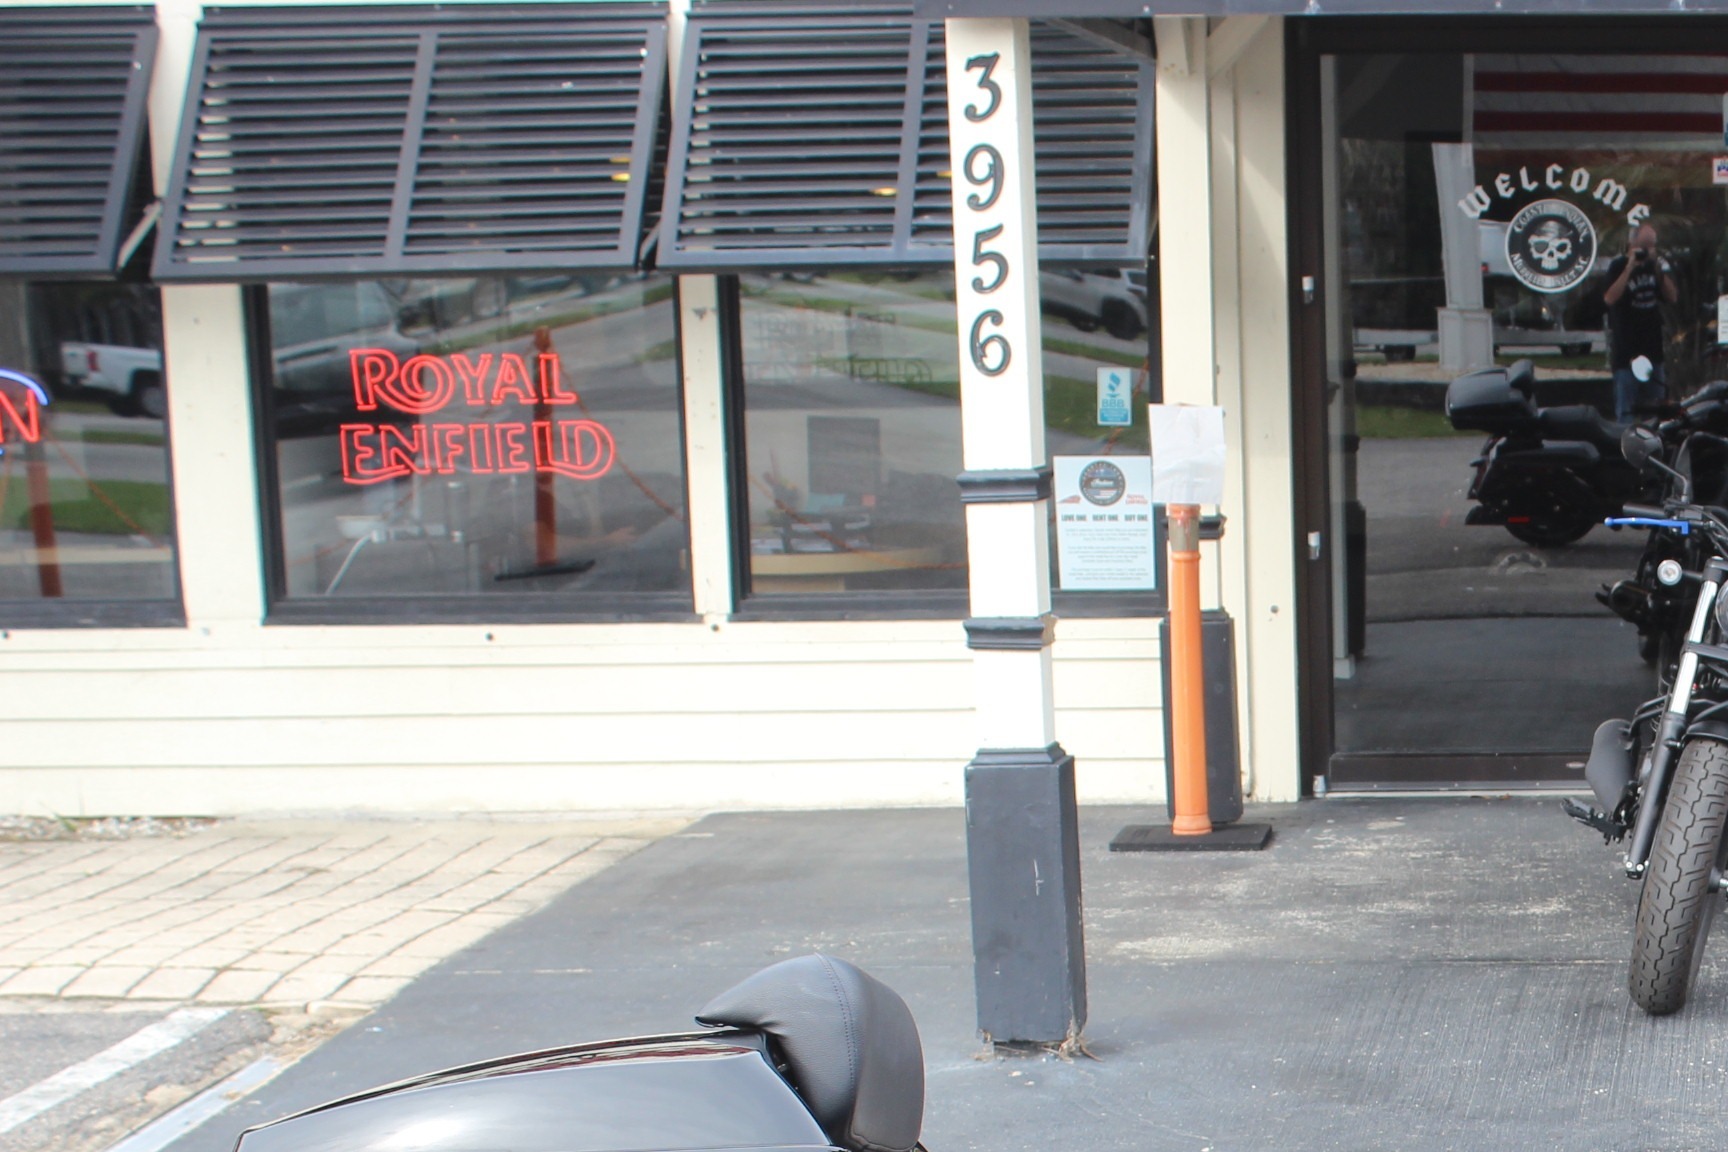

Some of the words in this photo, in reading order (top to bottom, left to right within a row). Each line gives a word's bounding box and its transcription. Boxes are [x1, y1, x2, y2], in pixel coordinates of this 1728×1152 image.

[963, 51, 1011, 377] 3956
[348, 348, 578, 415] ROYAL
[339, 420, 616, 485] ENFIELD
